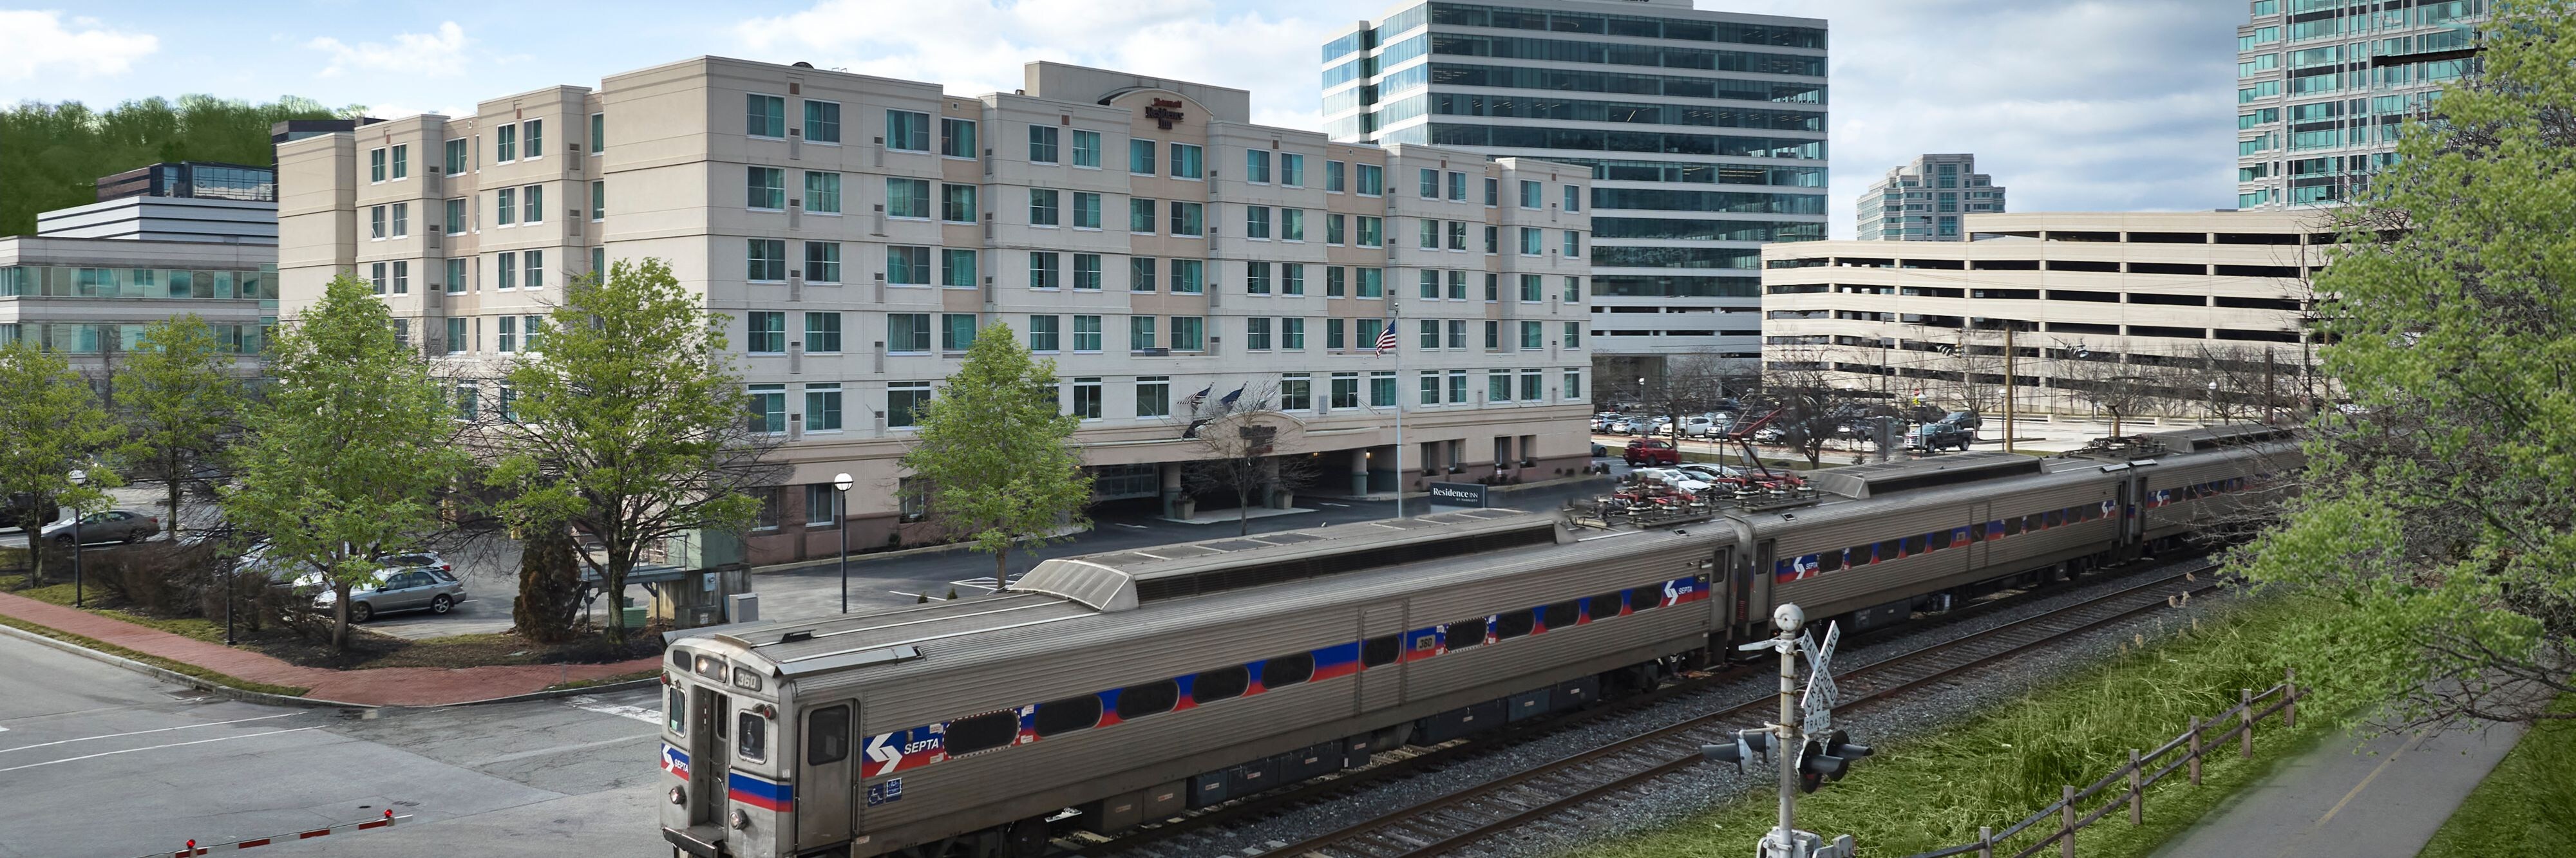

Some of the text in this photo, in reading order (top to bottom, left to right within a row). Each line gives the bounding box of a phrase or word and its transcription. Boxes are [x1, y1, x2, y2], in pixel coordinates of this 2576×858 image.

[1145, 106, 1184, 120] Residence
[1158, 118, 1172, 129] Inn
[1433, 488, 1468, 498] Residence
[1678, 586, 1692, 595] SEPTA
[1806, 630, 1837, 708] CROSSING
[738, 673, 757, 688] 360
[1816, 698, 1821, 712] 2
[1806, 714, 1830, 731] TRACKS
[904, 738, 939, 754] SEPTA
[674, 758, 689, 773] SEPTA
